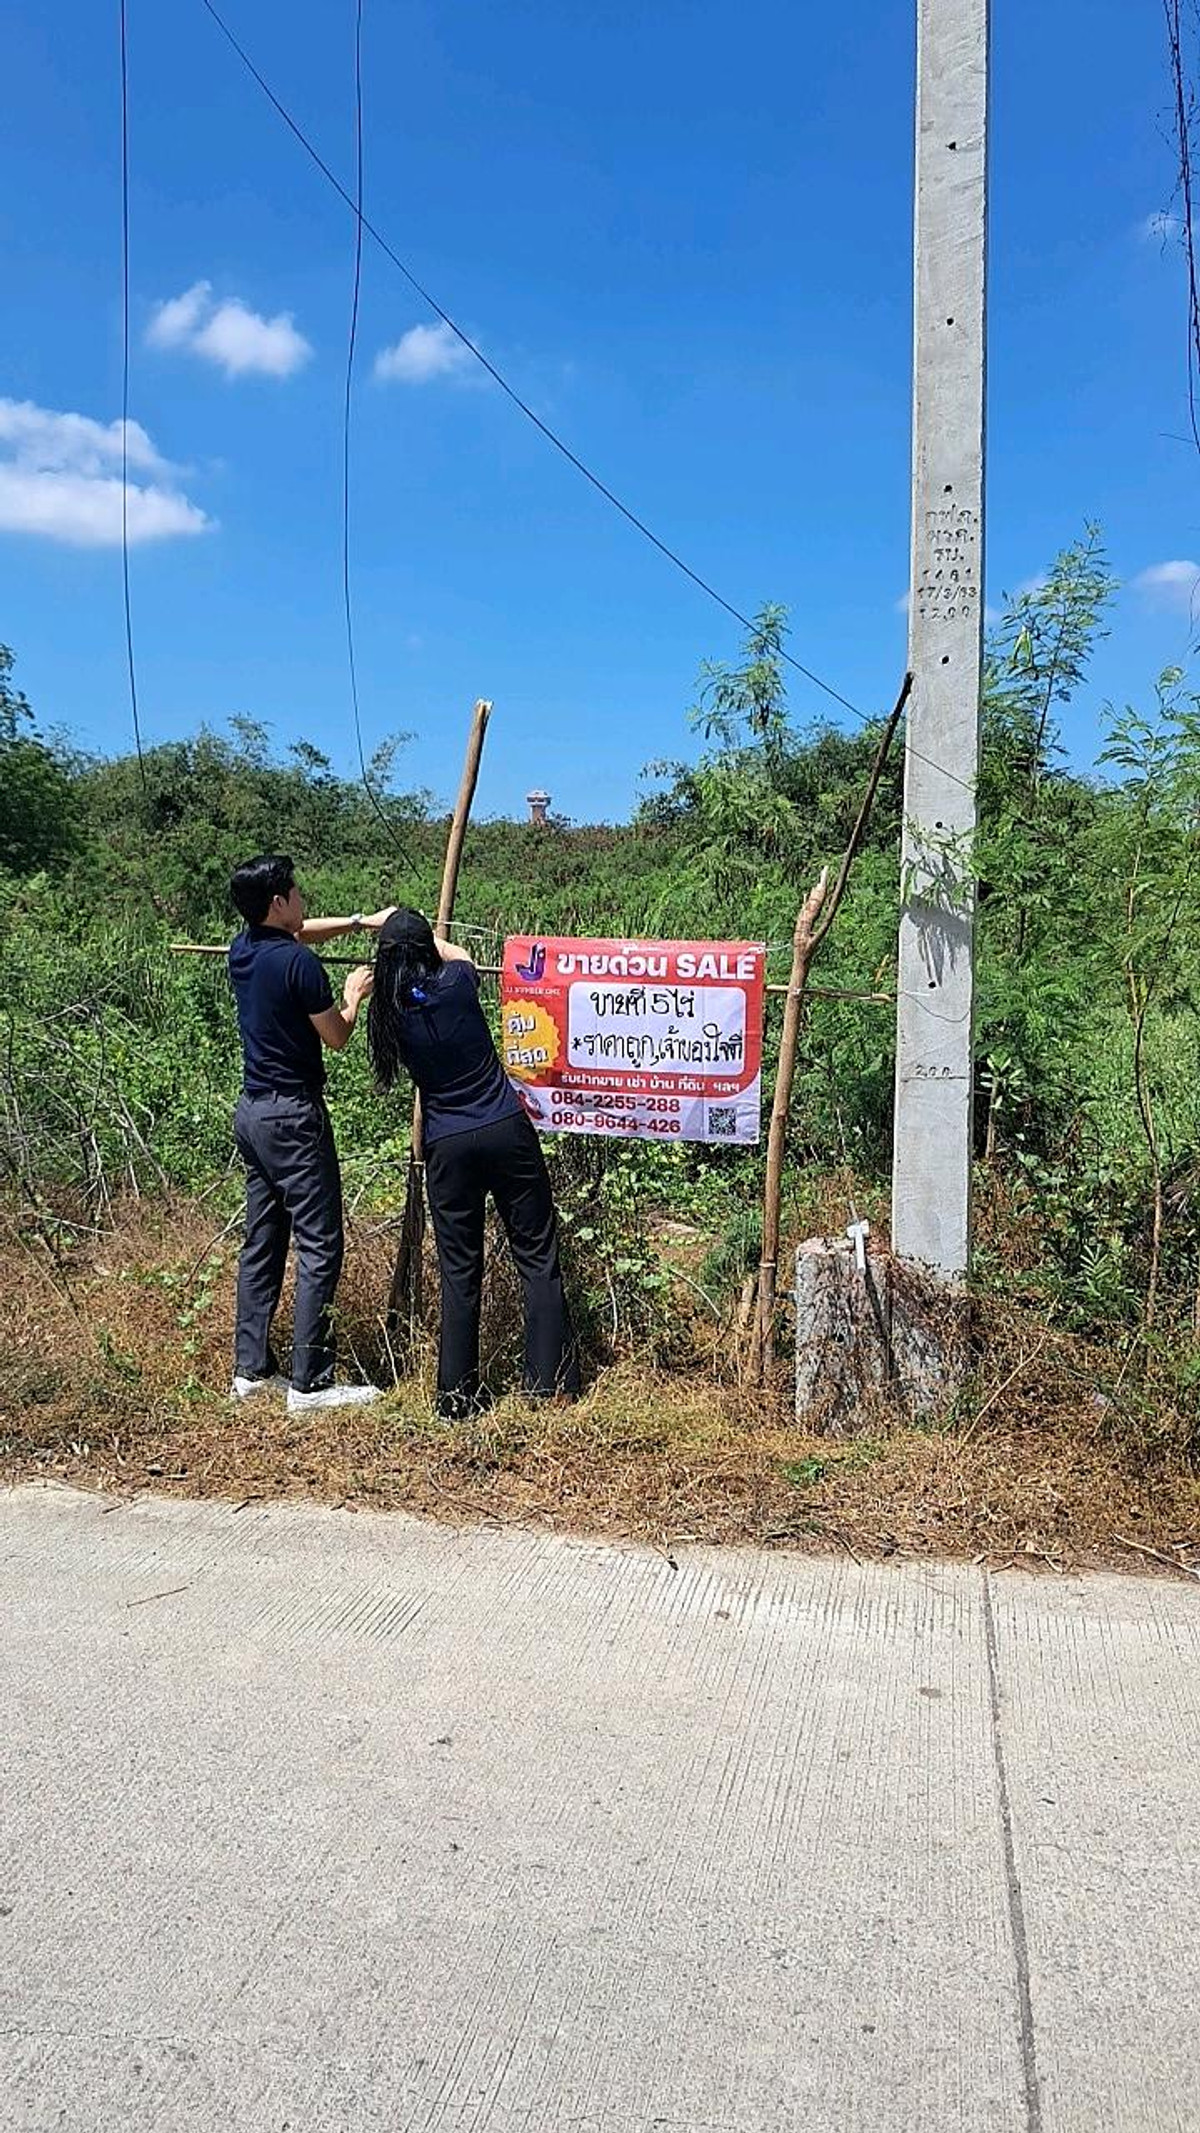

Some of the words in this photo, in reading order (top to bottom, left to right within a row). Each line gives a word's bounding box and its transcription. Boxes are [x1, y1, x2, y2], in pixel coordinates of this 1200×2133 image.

[676, 953, 756, 980] SALE
[650, 1075, 674, 1090] บ้าน
[678, 1076, 705, 1091] ที่ดิน
[551, 1090, 680, 1113] 084-2255-288
[551, 1111, 681, 1133] 080-9644-426
